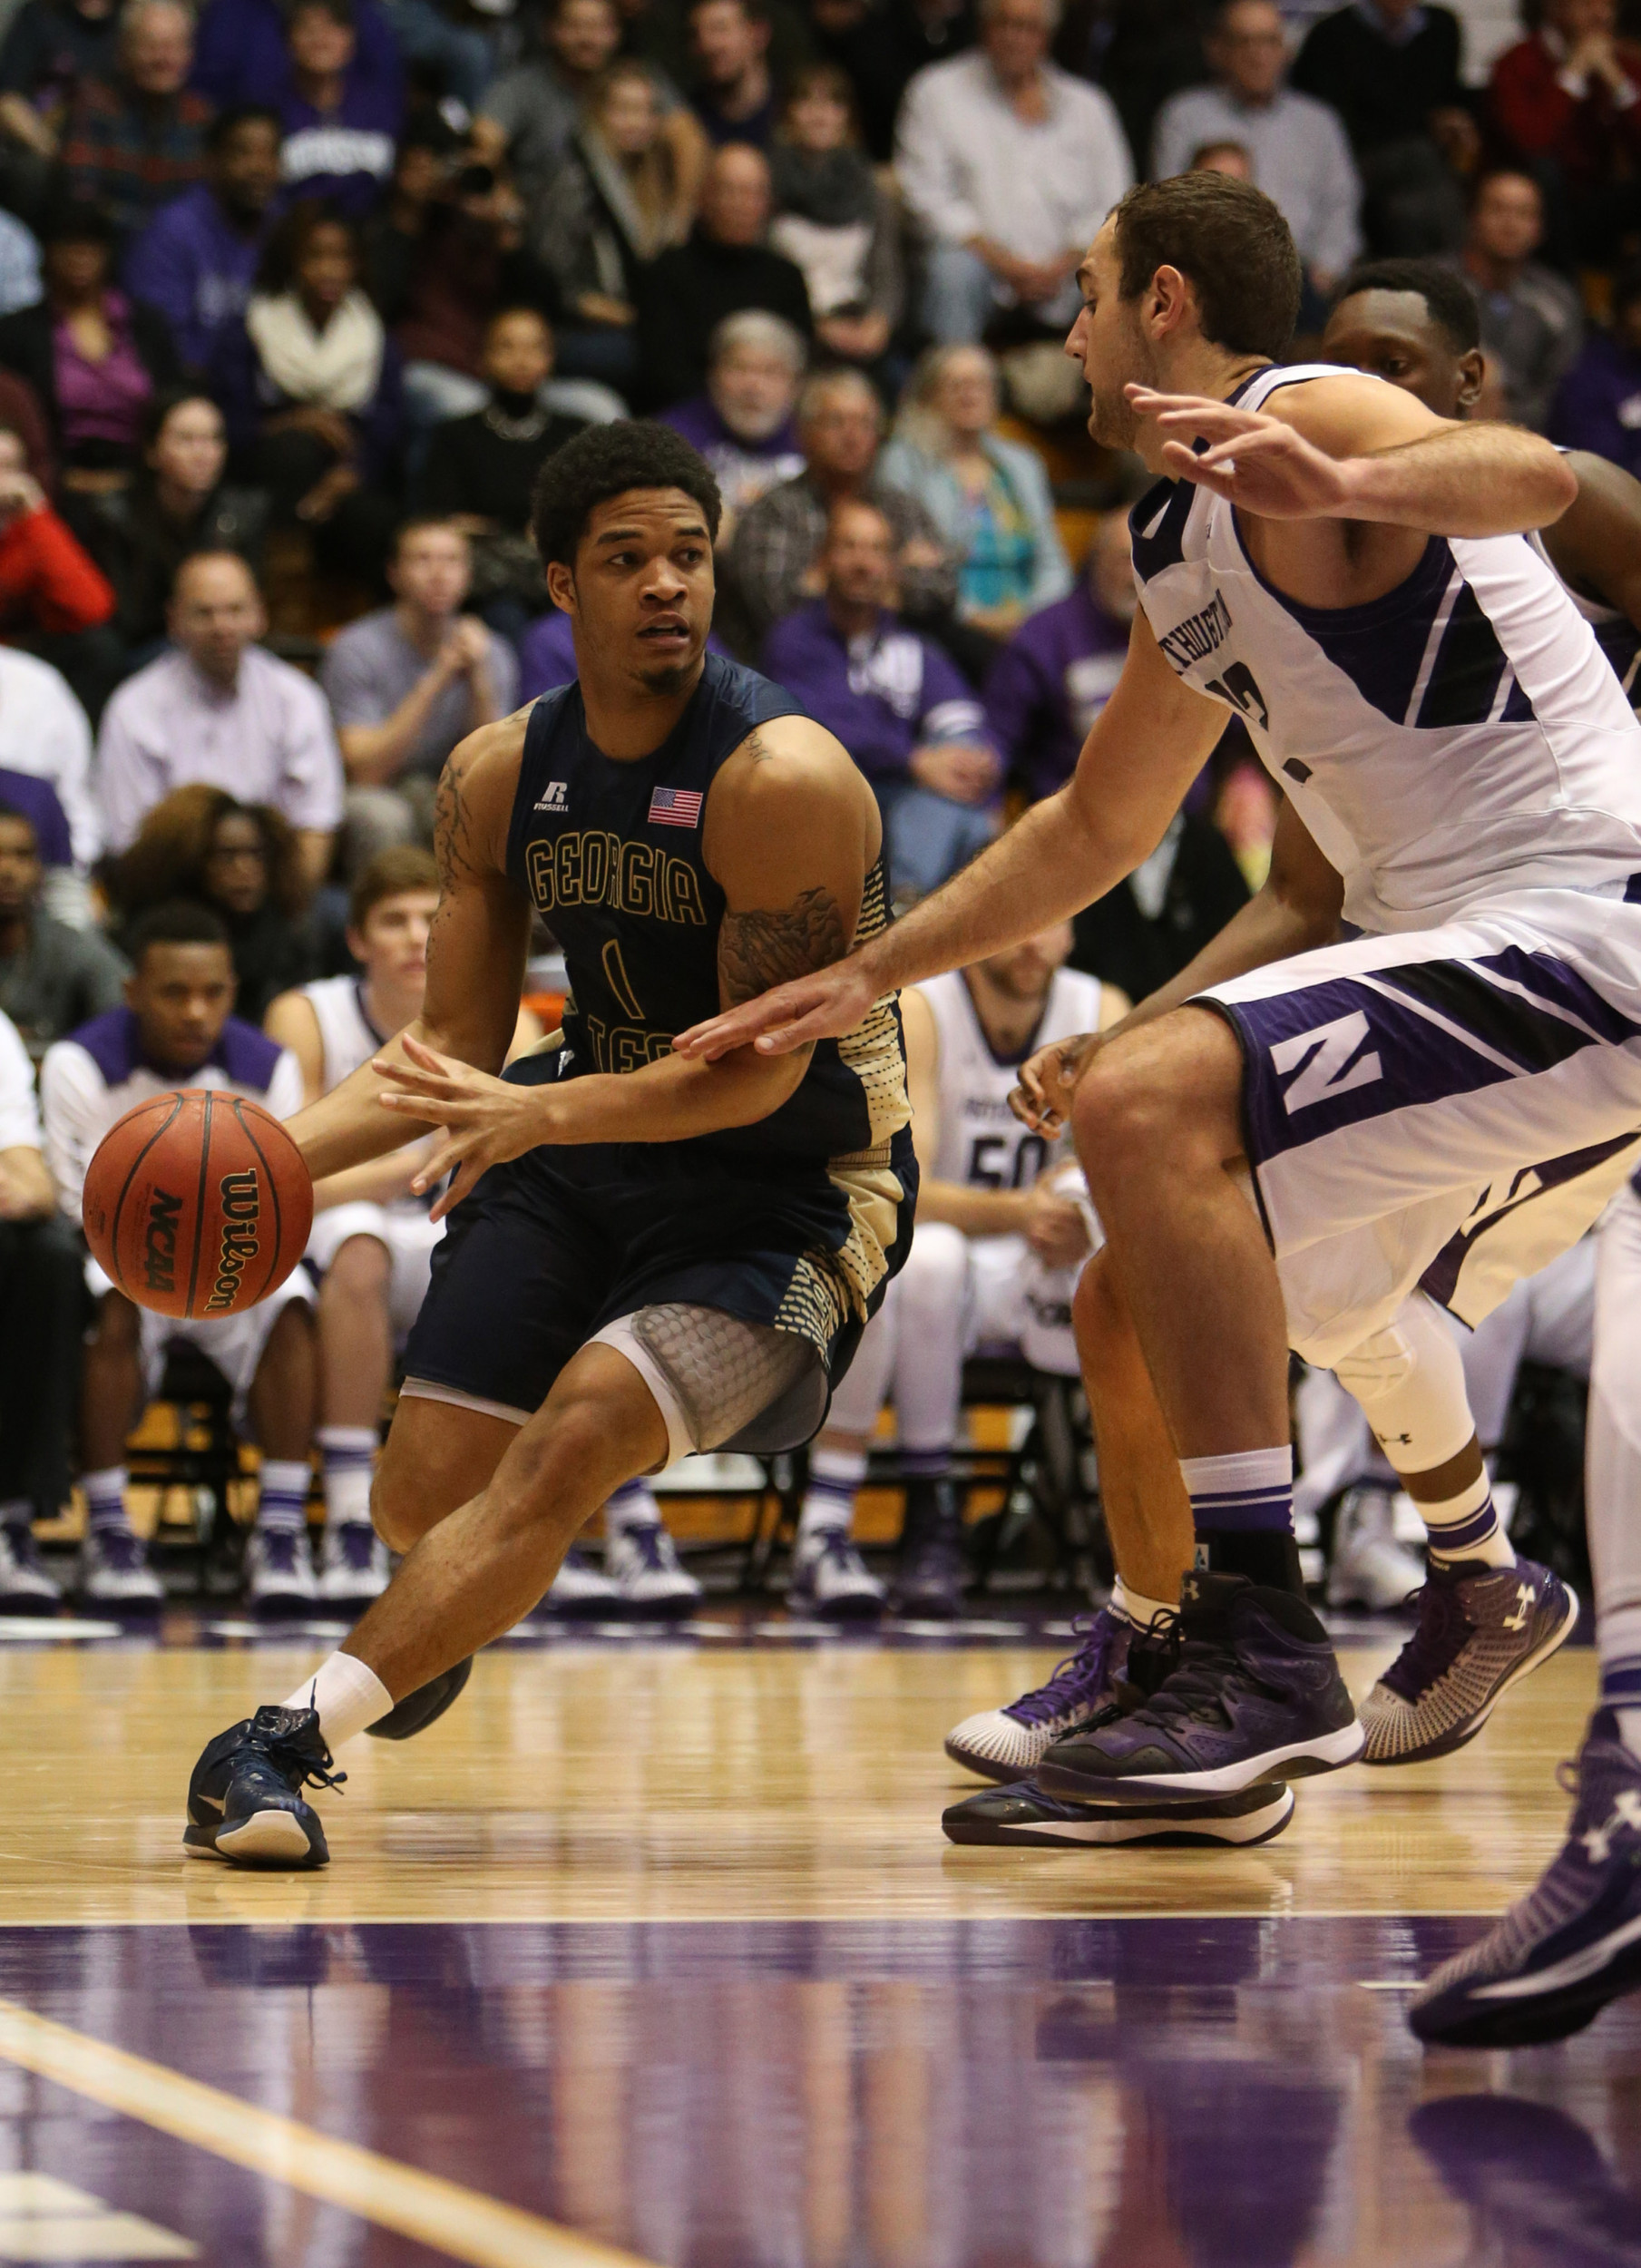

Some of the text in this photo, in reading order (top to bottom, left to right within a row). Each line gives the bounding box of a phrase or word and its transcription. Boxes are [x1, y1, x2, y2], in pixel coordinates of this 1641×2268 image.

[532, 802, 570, 813] RUSSELL
[525, 830, 708, 926] GEORGIA
[601, 938, 647, 1021] 1
[1269, 1009, 1384, 1117] N
[968, 1134, 1050, 1188] 50
[143, 1186, 183, 1294] NCAA
[203, 1168, 260, 1312] Wilson
